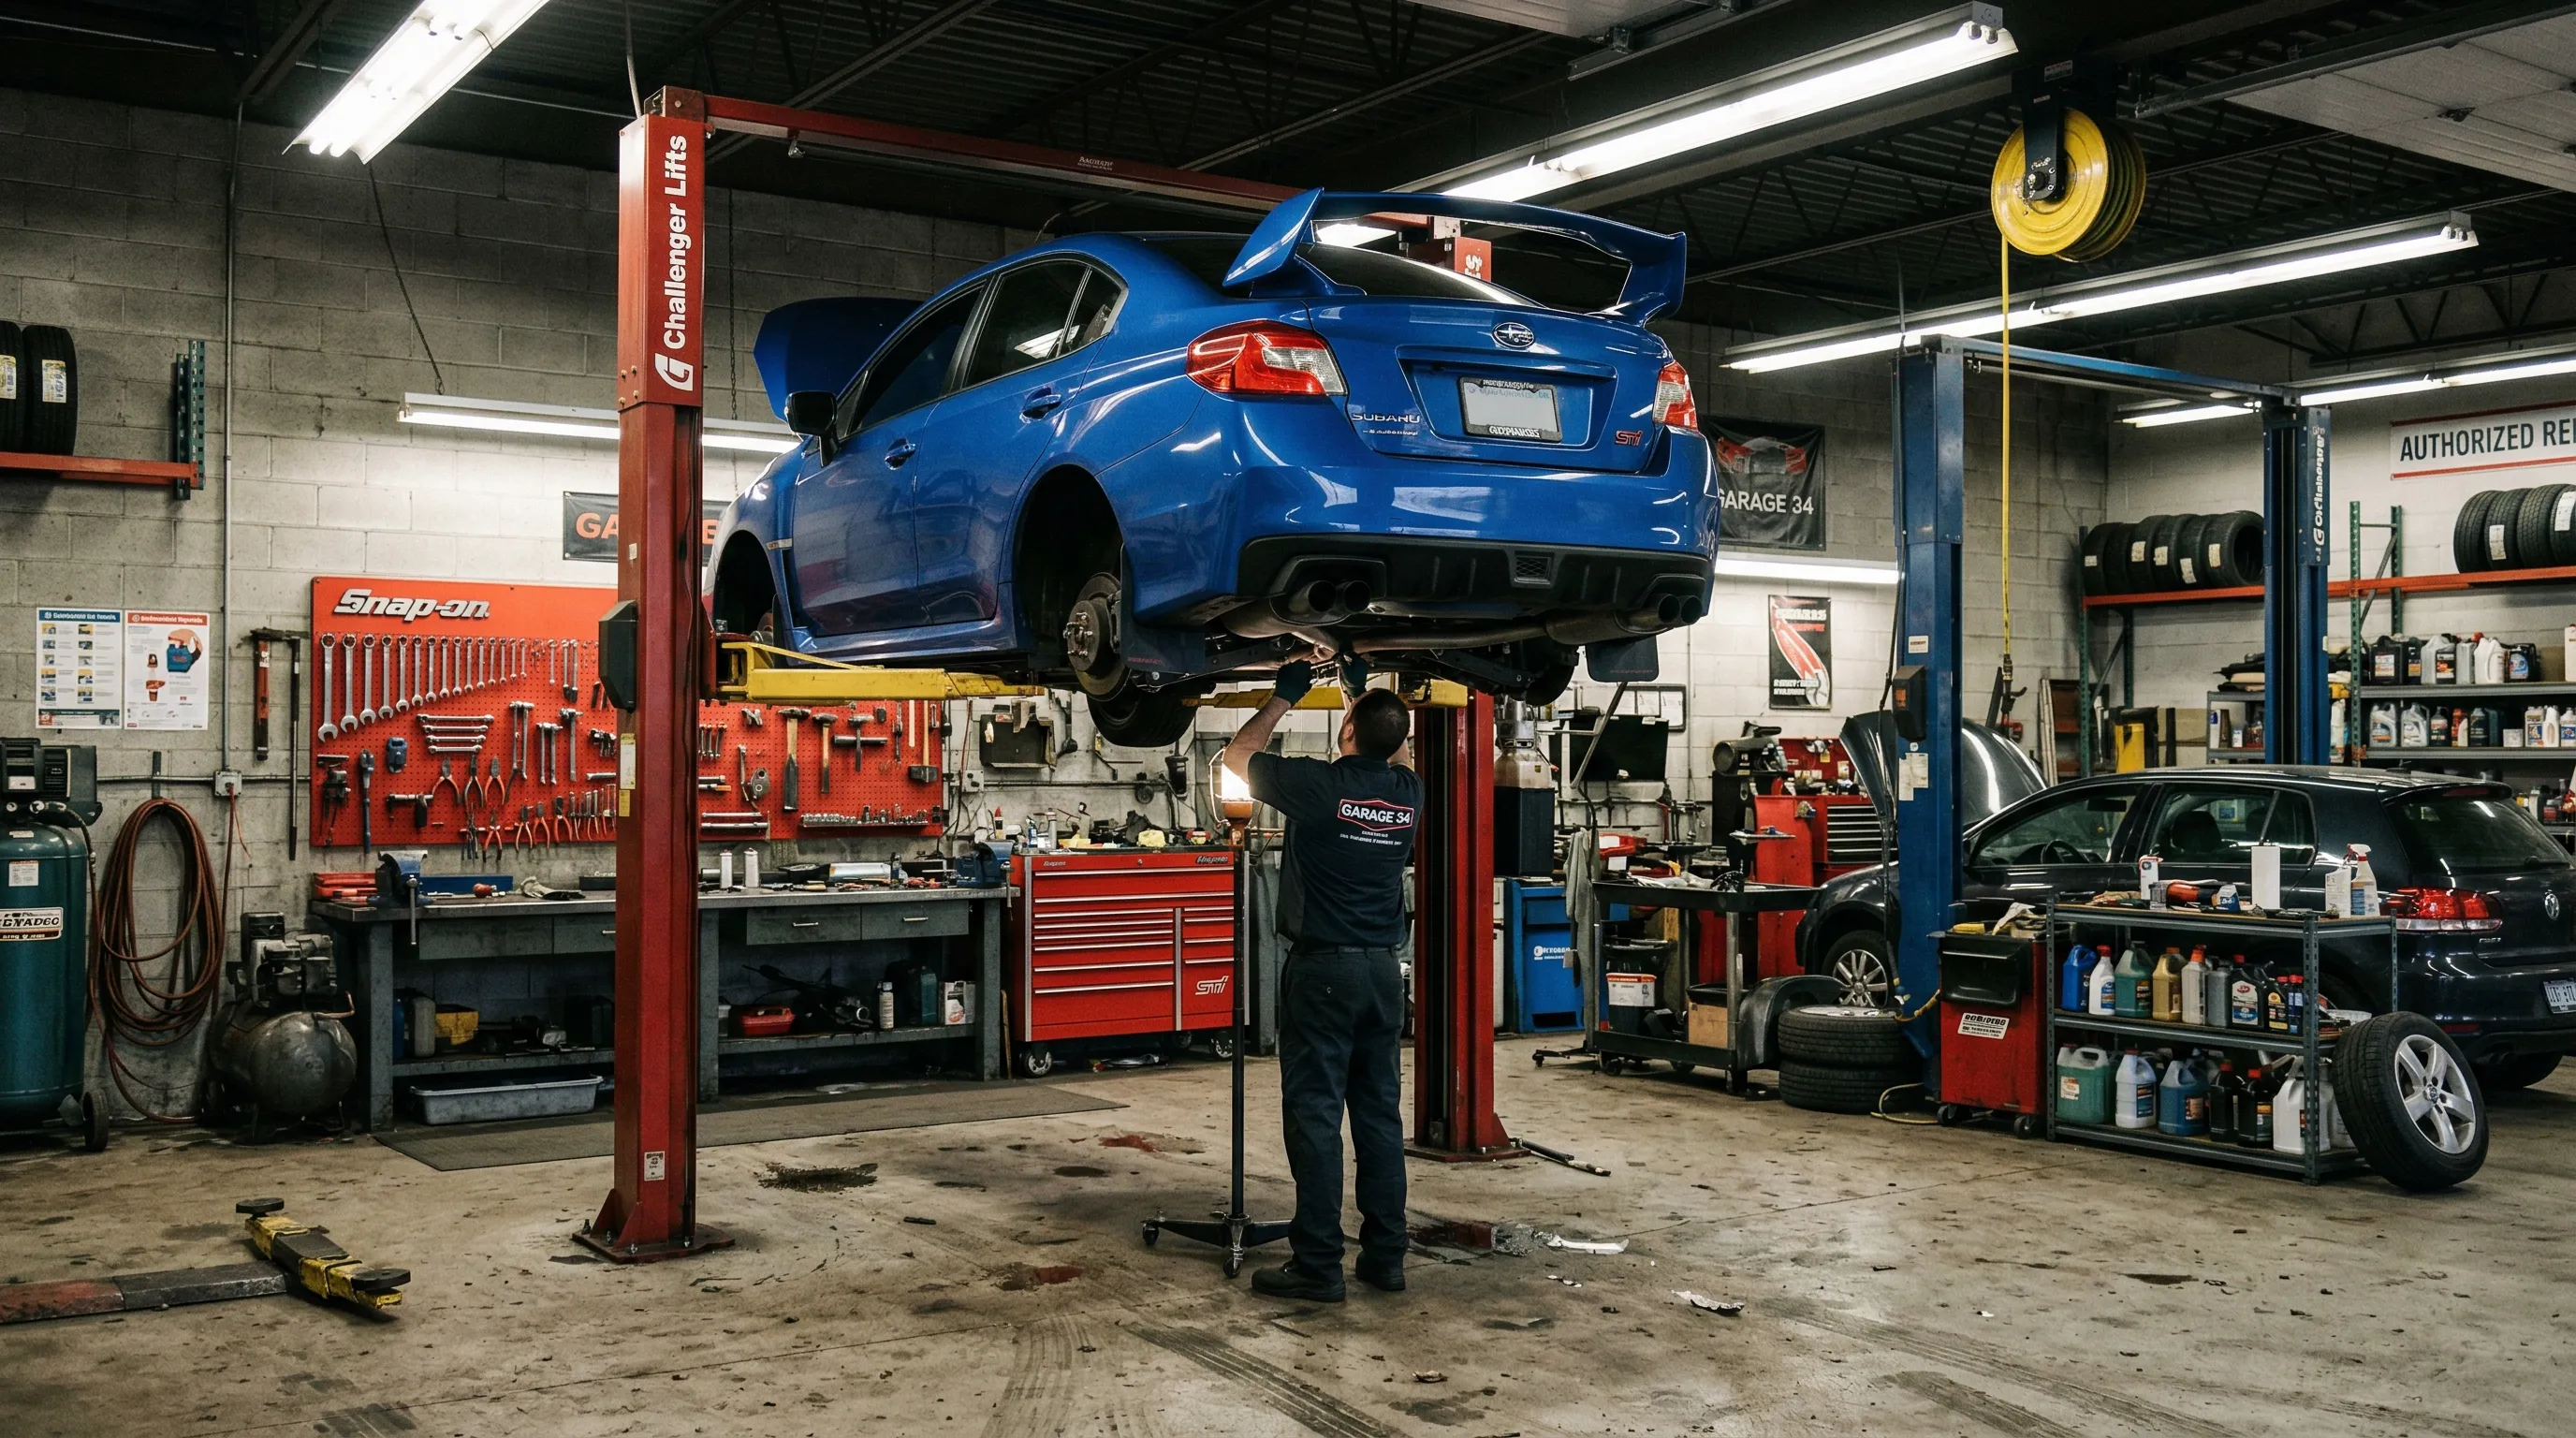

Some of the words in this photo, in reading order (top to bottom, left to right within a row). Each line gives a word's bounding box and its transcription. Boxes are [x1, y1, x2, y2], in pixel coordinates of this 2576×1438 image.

[664, 135, 686, 197] Lifts
[664, 203, 691, 349] Challenger
[2400, 423, 2534, 462] AUTHORIZED
[1792, 495, 1814, 515] 34
[1341, 803, 1395, 823] GARAGE
